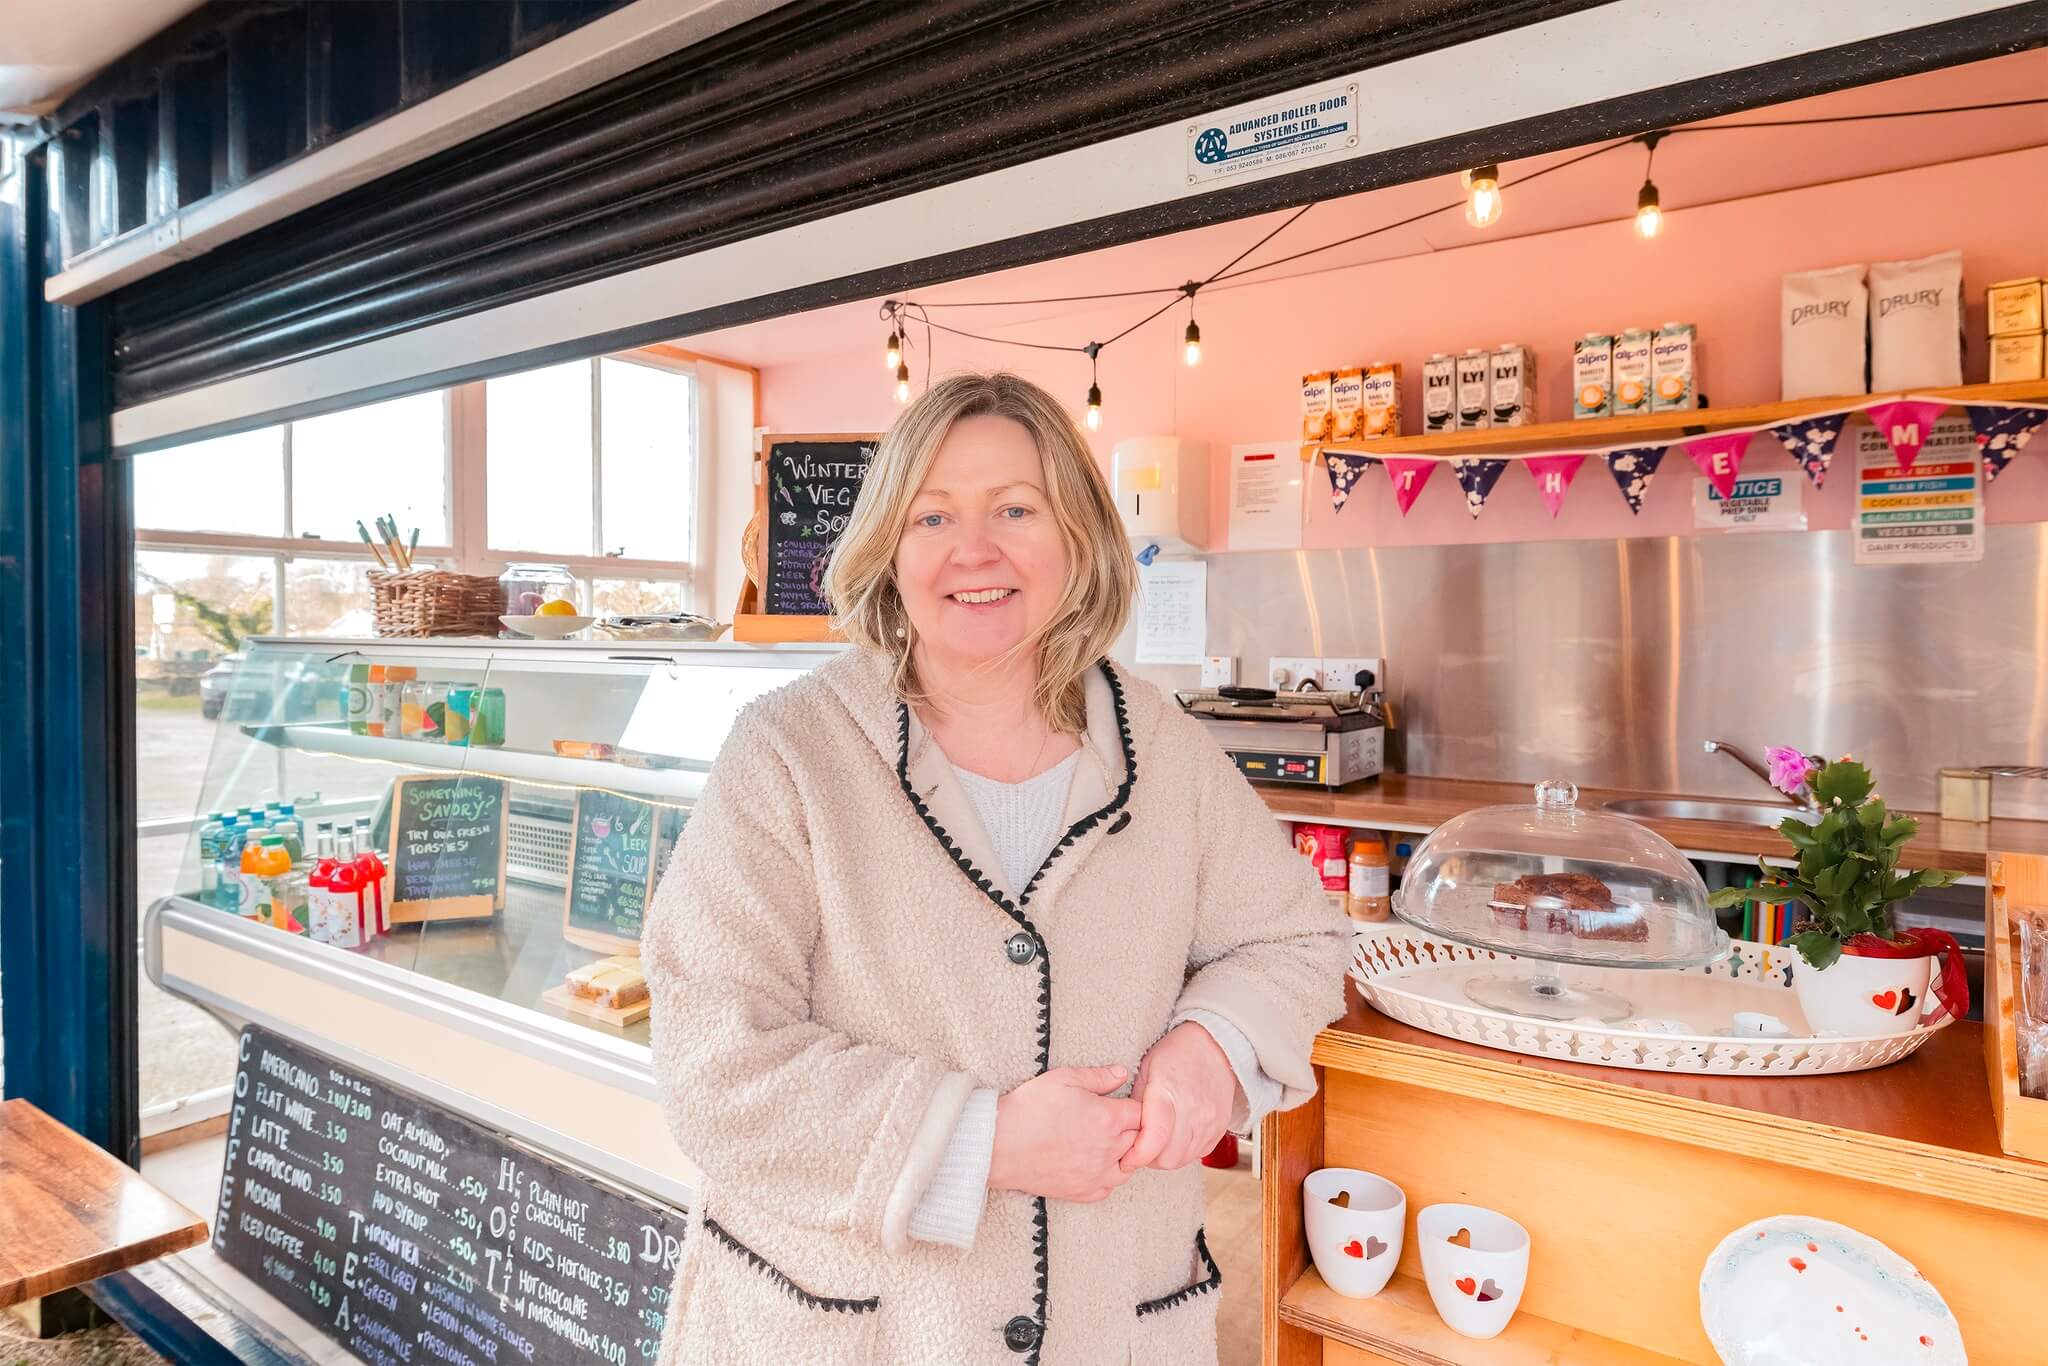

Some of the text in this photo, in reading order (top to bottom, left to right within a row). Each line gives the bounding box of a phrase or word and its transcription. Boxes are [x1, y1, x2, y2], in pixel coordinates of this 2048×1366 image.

[1229, 95, 1348, 136] ADVANCED ROLLER DOOR
[1254, 117, 1321, 143] SYSTEMS LTD.
[1791, 299, 1851, 326] DRURY
[1879, 288, 1944, 318] DRURY
[1576, 353, 1608, 366] alpro
[1654, 343, 1688, 355] alpro
[1365, 380, 1392, 391] alpro
[1429, 375, 1450, 388] LY!
[1463, 370, 1484, 384] LY!
[1496, 366, 1518, 379] LY!
[1334, 383, 1360, 395] alpro
[783, 454, 869, 480] WINTER
[1402, 470, 1416, 490] T
[1546, 472, 1561, 493] H
[1712, 452, 1730, 475] E
[1891, 423, 1919, 447] M
[806, 483, 850, 506] VEG
[1711, 480, 1780, 498] NTICE
[1871, 495, 1965, 508] COOKED MEATS
[1876, 526, 1957, 537] VEGETABLES
[409, 786, 483, 806] SOMETHING
[419, 795, 496, 822] SAVORY?
[406, 824, 491, 841] TRY OUR FRESH
[622, 833, 648, 851] LEEK
[622, 854, 647, 874] SOUP
[260, 1049, 319, 1097] AMERICANO
[255, 1081, 285, 1113] FLAT
[251, 1114, 291, 1150] LATTE
[246, 1146, 313, 1193] CAPPUCCINO
[378, 1136, 426, 1171] COCONUT
[425, 1159, 448, 1183] MILK
[244, 1177, 283, 1215] MOCHA
[375, 1162, 412, 1195] EXTRA
[412, 1181, 440, 1208] SHOT
[372, 1190, 394, 1215] ADD
[394, 1200, 428, 1232] SYRUP
[529, 1180, 589, 1223] PLAIN HOT
[239, 1212, 265, 1240] ICED
[264, 1223, 305, 1260] COFFEE
[525, 1203, 587, 1244] CHOCOLATE
[368, 1223, 401, 1255] IRISH
[400, 1239, 419, 1267] TEA
[522, 1235, 555, 1269] KIDS
[557, 1254, 580, 1279] HOT
[639, 1224, 683, 1272] DR
[367, 1252, 419, 1295] EARL GREY
[363, 1277, 398, 1312] GREEN
[519, 1269, 589, 1321] HOT CHOCOLATE
[427, 1300, 498, 1365] LEMON GINGER
[498, 1322, 536, 1364] FLOWER
